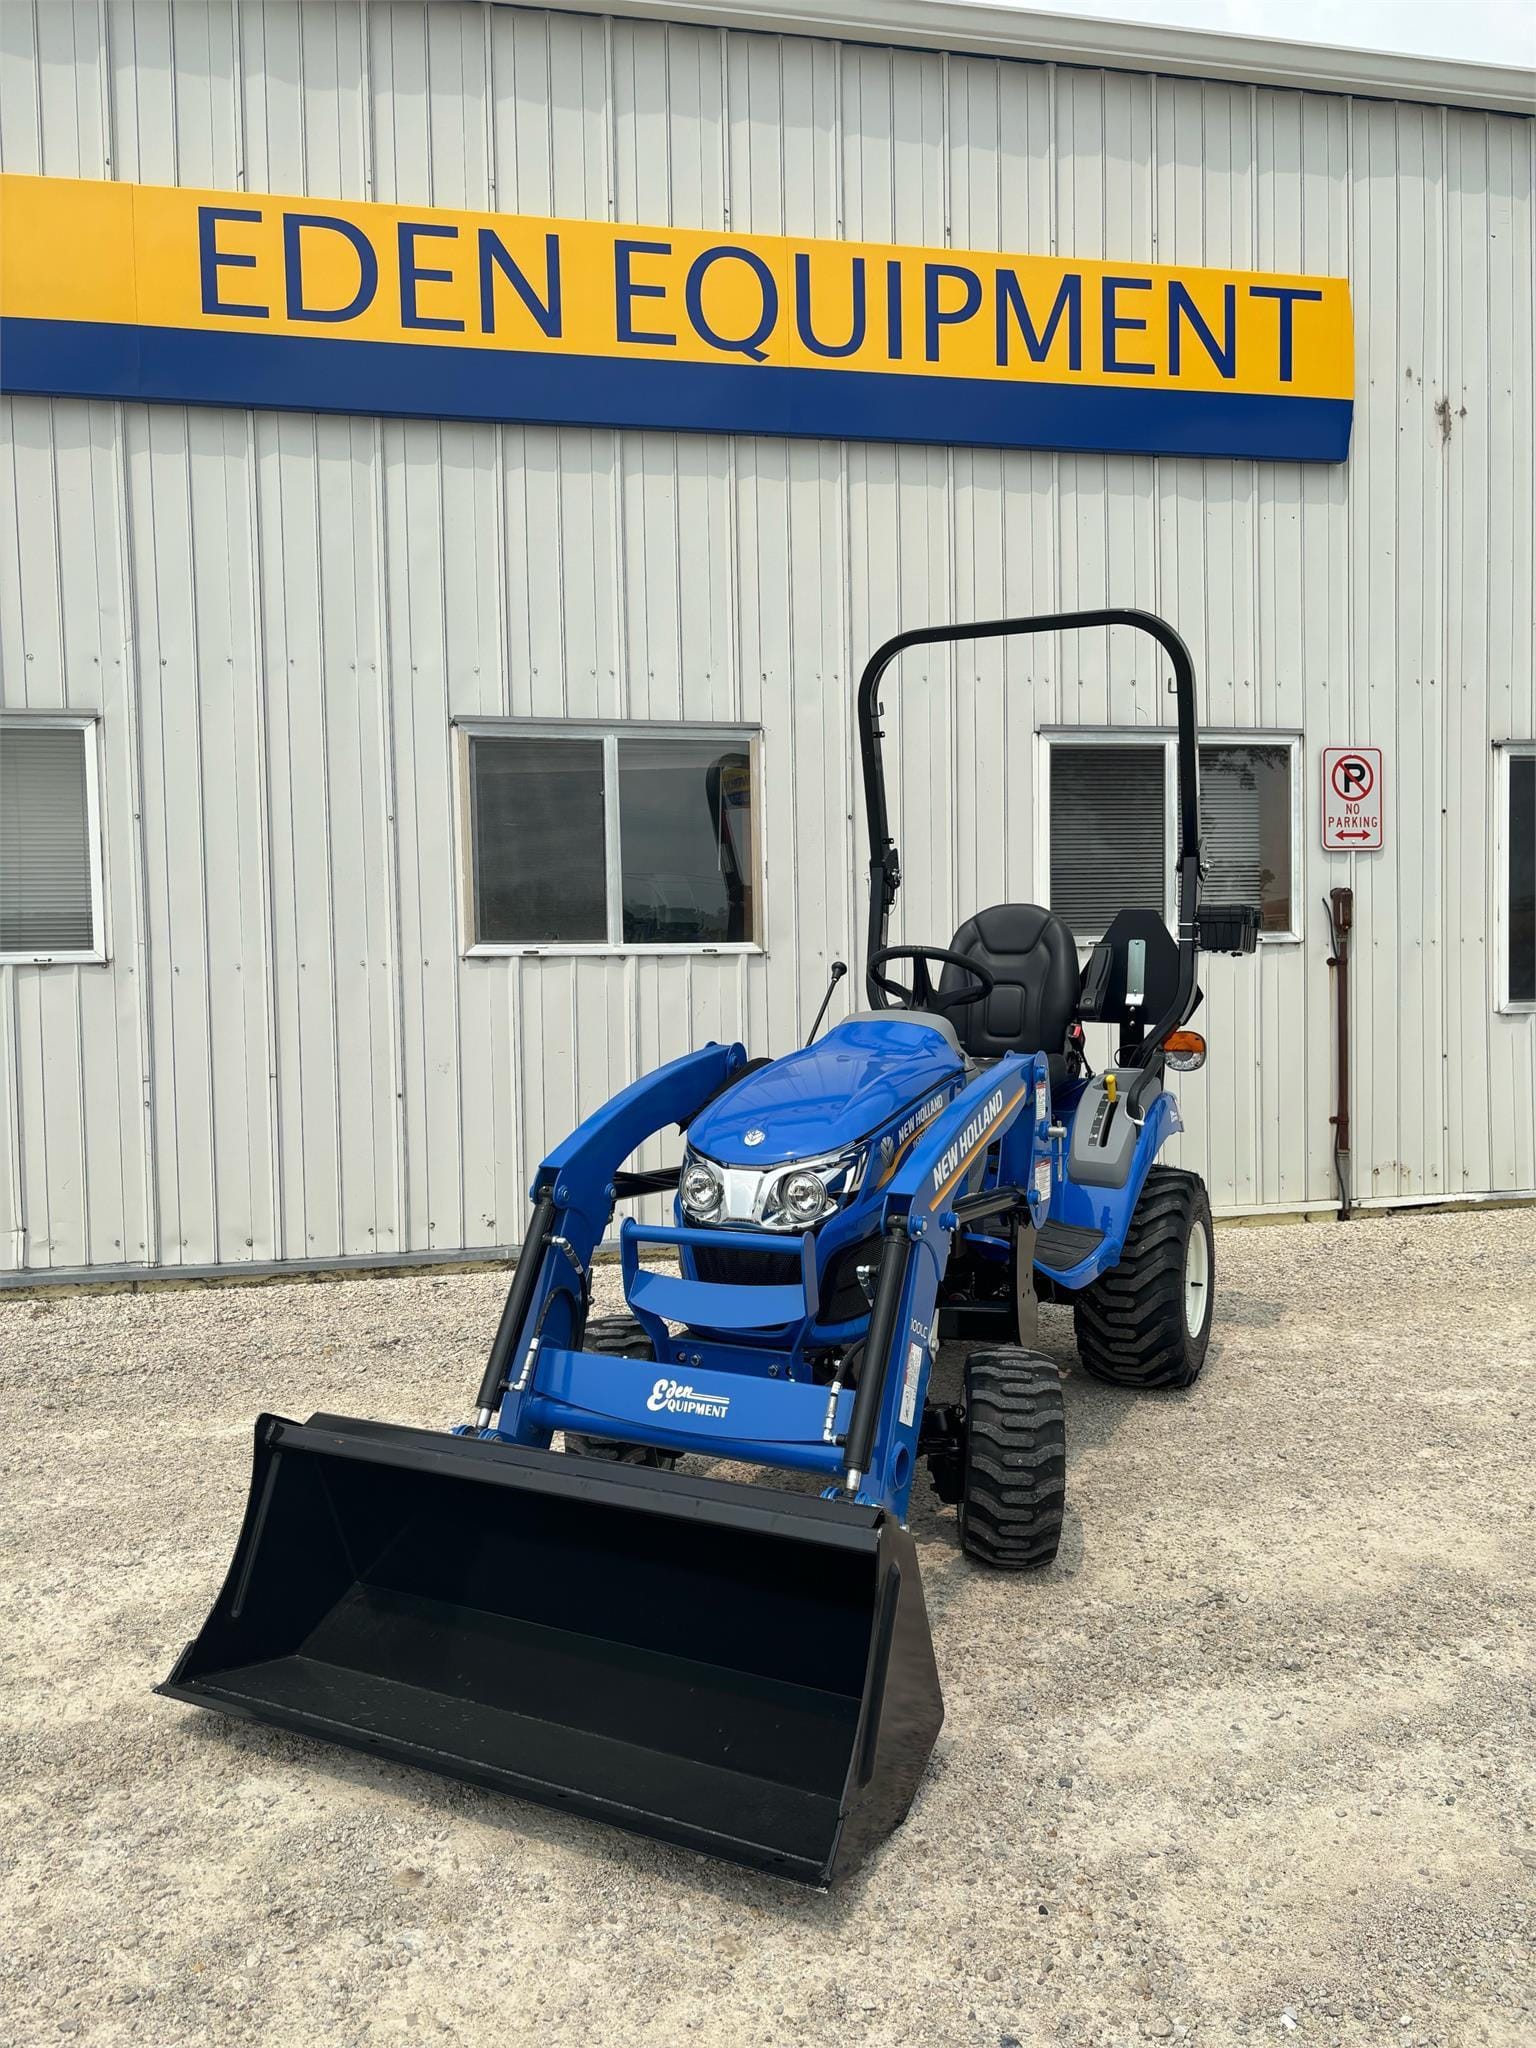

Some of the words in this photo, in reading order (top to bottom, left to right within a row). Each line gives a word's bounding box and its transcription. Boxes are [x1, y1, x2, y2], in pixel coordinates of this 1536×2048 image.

[198, 206, 563, 339] EDEN
[613, 239, 1324, 383] EQUIPMENT
[1328, 816, 1378, 828] PARKING
[1345, 803, 1360, 815] NO
[898, 1114, 914, 1145] NEW
[914, 1094, 943, 1127] HOLLAND
[933, 1142, 958, 1191] NEW
[959, 1089, 1003, 1158] HOLLAND
[646, 1378, 693, 1412] Eden
